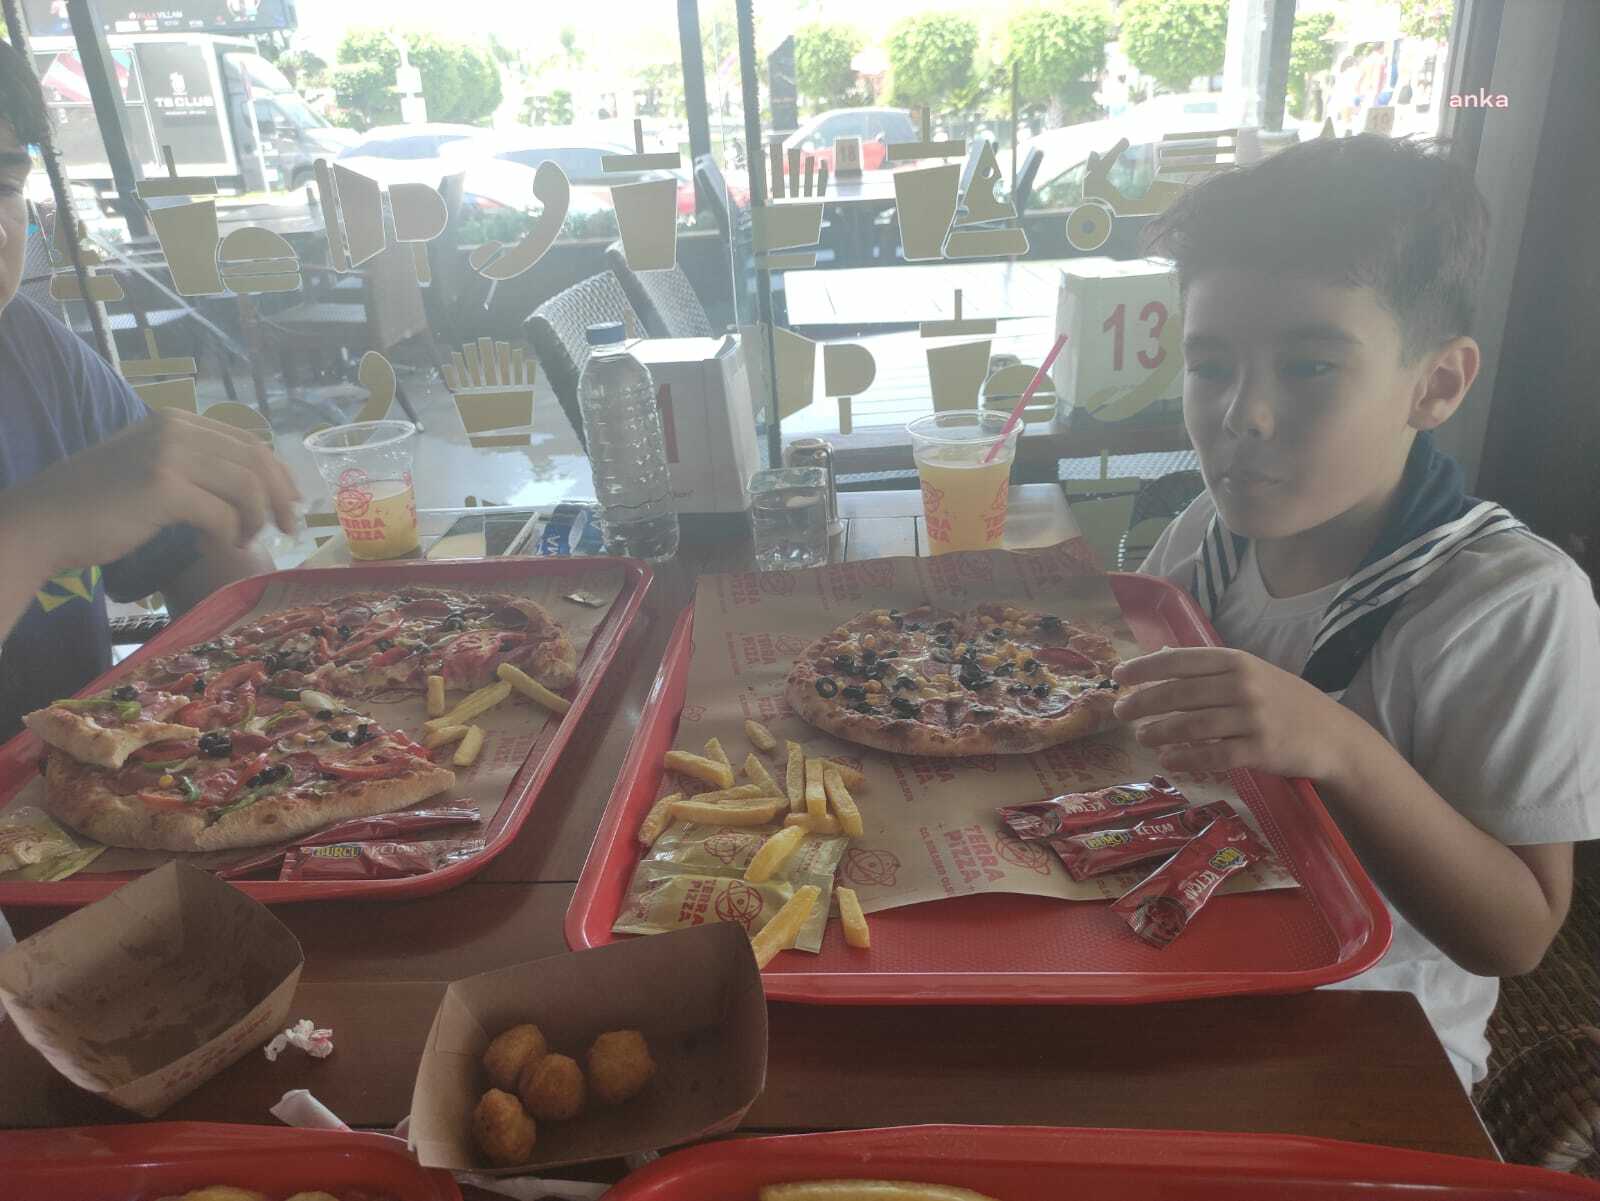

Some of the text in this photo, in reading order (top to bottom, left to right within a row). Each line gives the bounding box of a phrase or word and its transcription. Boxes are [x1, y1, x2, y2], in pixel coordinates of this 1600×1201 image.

[1104, 301, 1168, 371] 13
[678, 880, 702, 923] PIZZA
[690, 879, 718, 926] TERRA
